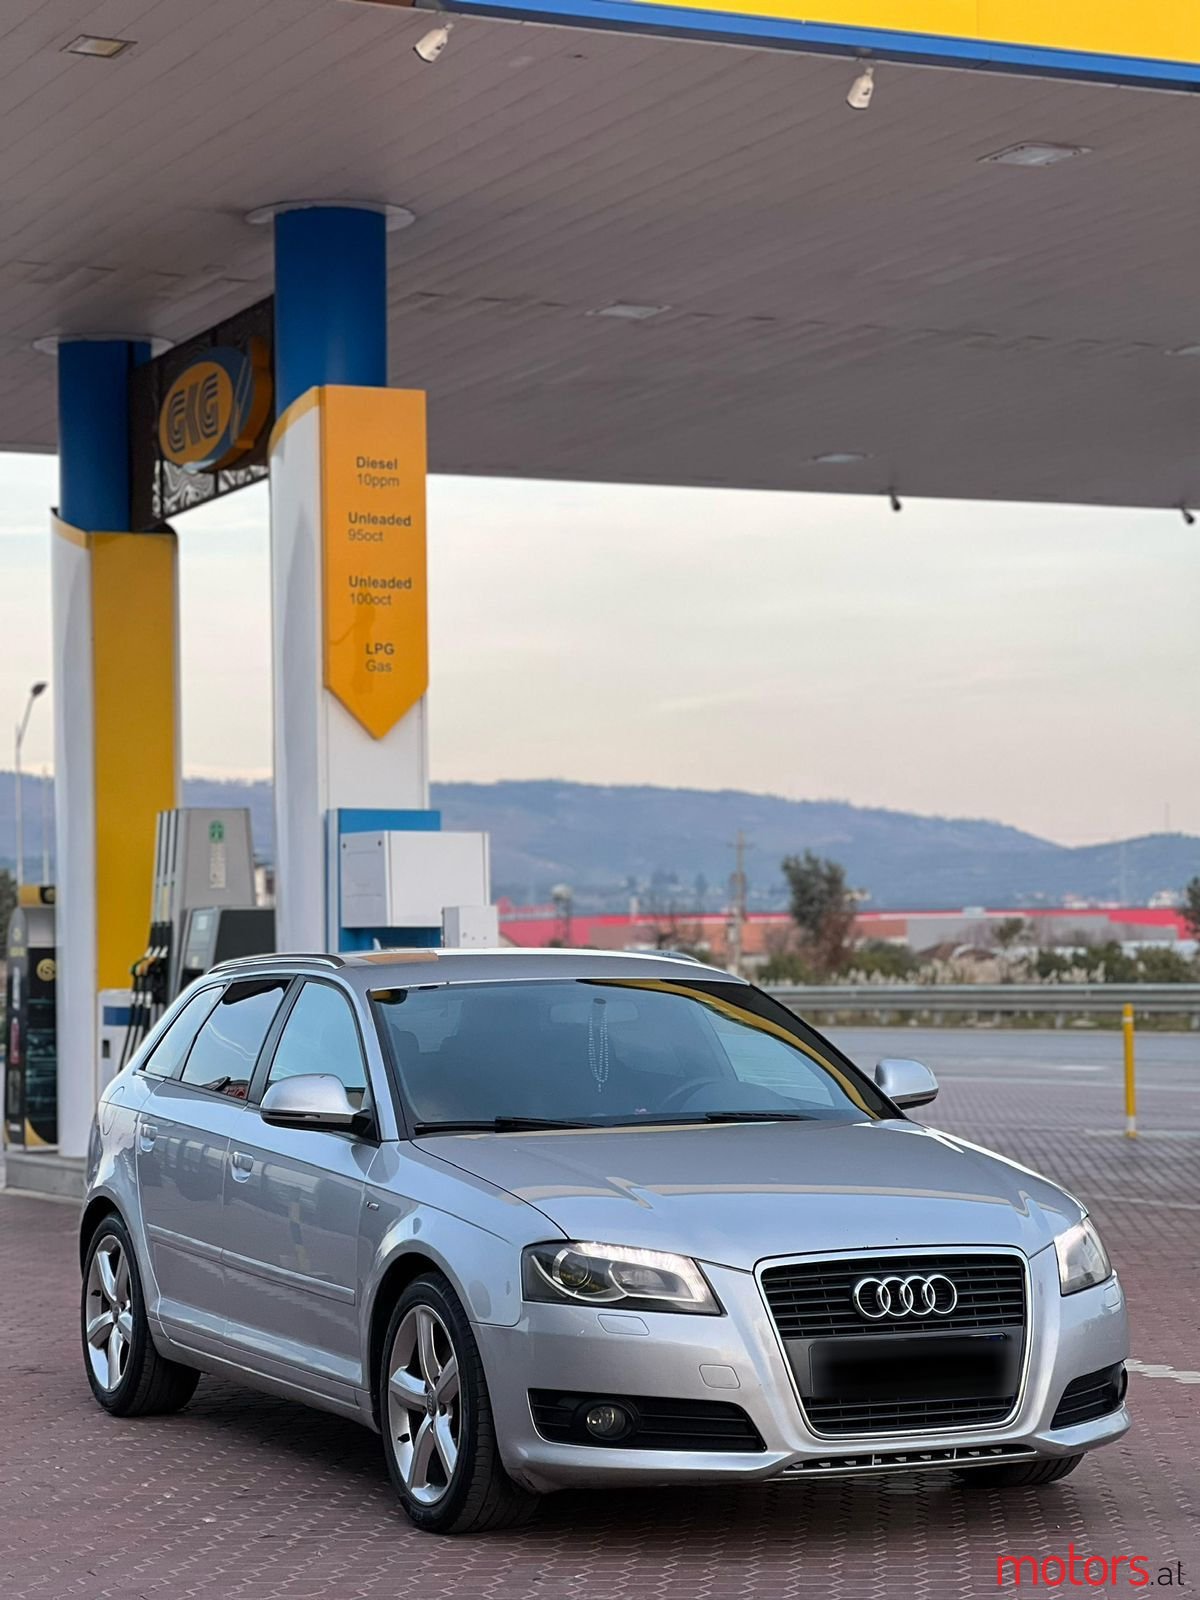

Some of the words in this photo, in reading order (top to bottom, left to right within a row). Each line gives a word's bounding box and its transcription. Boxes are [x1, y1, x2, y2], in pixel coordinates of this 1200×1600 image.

[356, 456, 398, 470] Diesel
[357, 473, 400, 488] 10ppm
[348, 512, 411, 526] Unleaded
[348, 528, 383, 541] 95oct
[349, 575, 412, 589] Unleaded
[350, 592, 392, 606] 100oct
[365, 642, 395, 655] LPG
[365, 659, 393, 673] Gas
